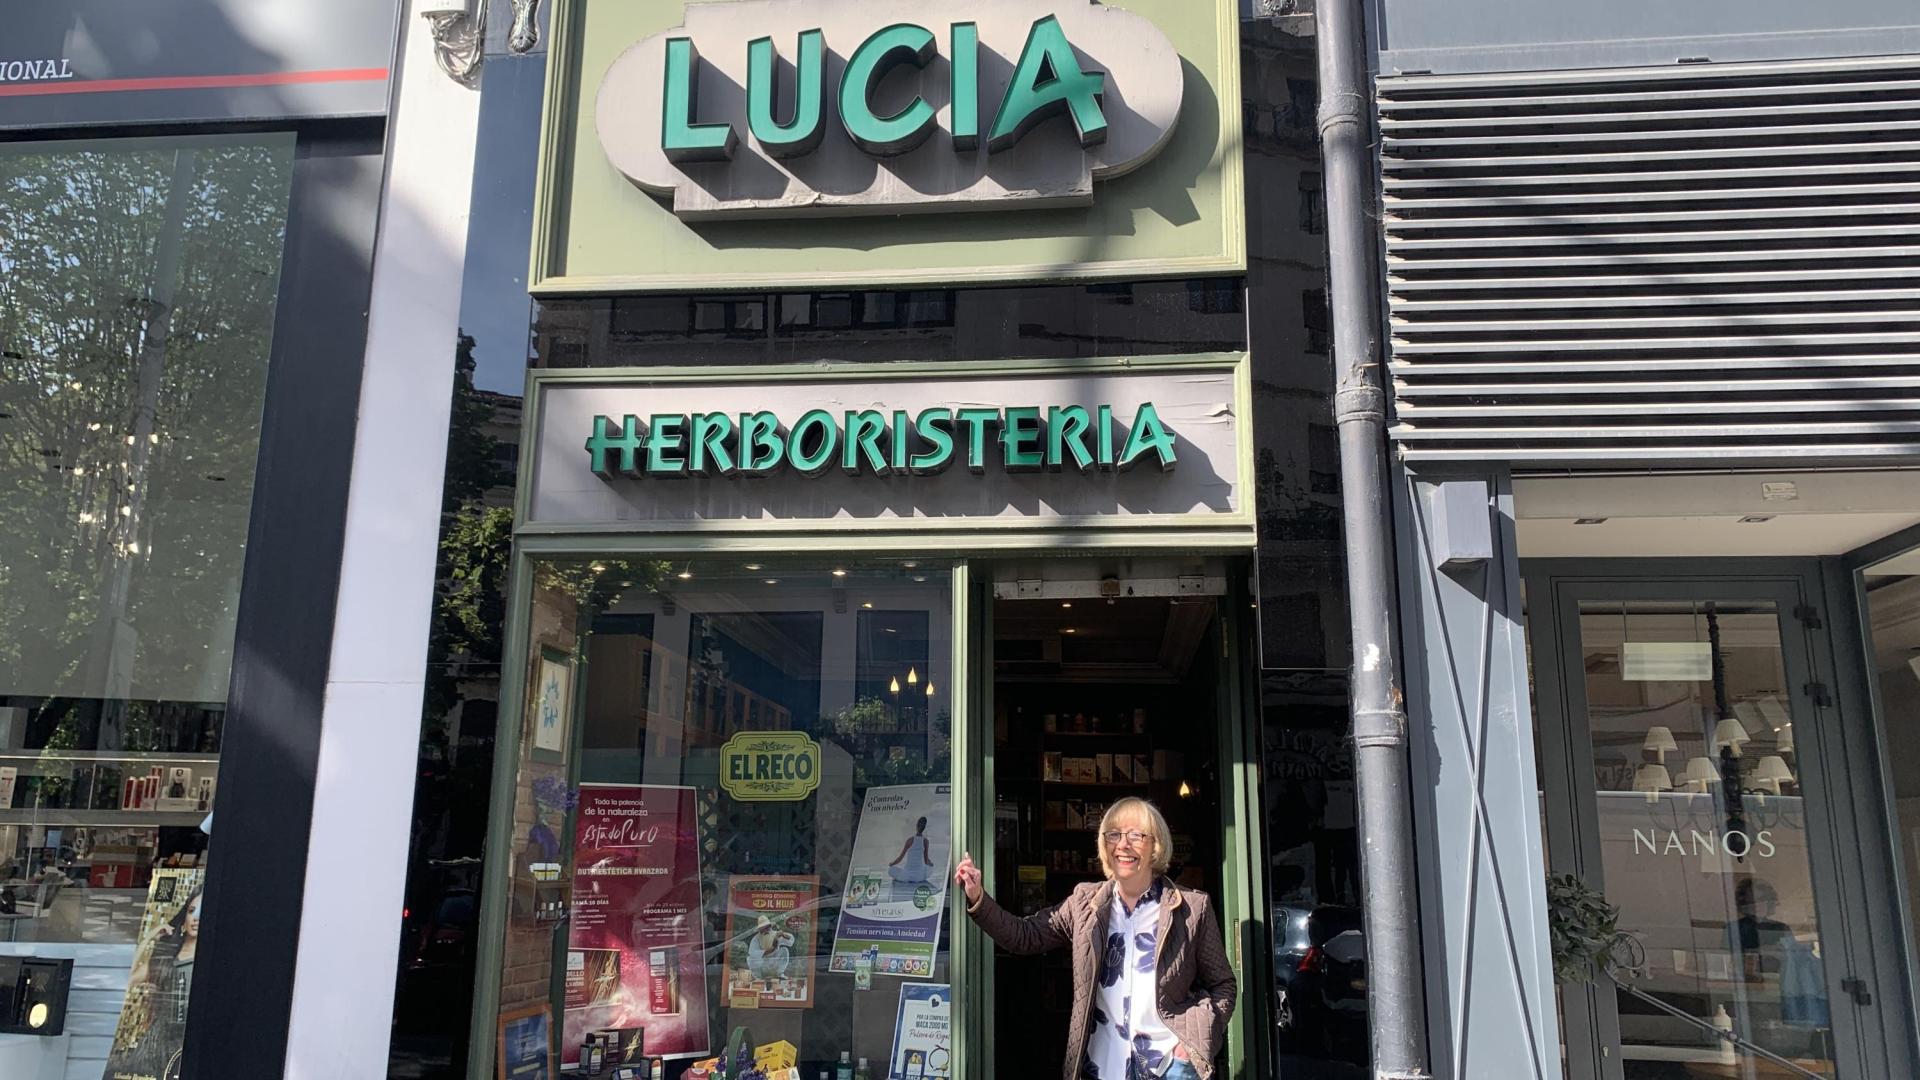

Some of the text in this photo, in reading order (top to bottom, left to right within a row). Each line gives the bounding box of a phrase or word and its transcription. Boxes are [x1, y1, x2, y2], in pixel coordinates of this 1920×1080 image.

[0, 58, 73, 81] IONAL
[661, 13, 1108, 158] LUCIA
[585, 402, 1177, 478] HERBORISTERIA
[730, 750, 813, 780] EL RECÓ
[584, 807, 648, 817] de la naturaleza
[1632, 828, 1776, 858] NANOS
